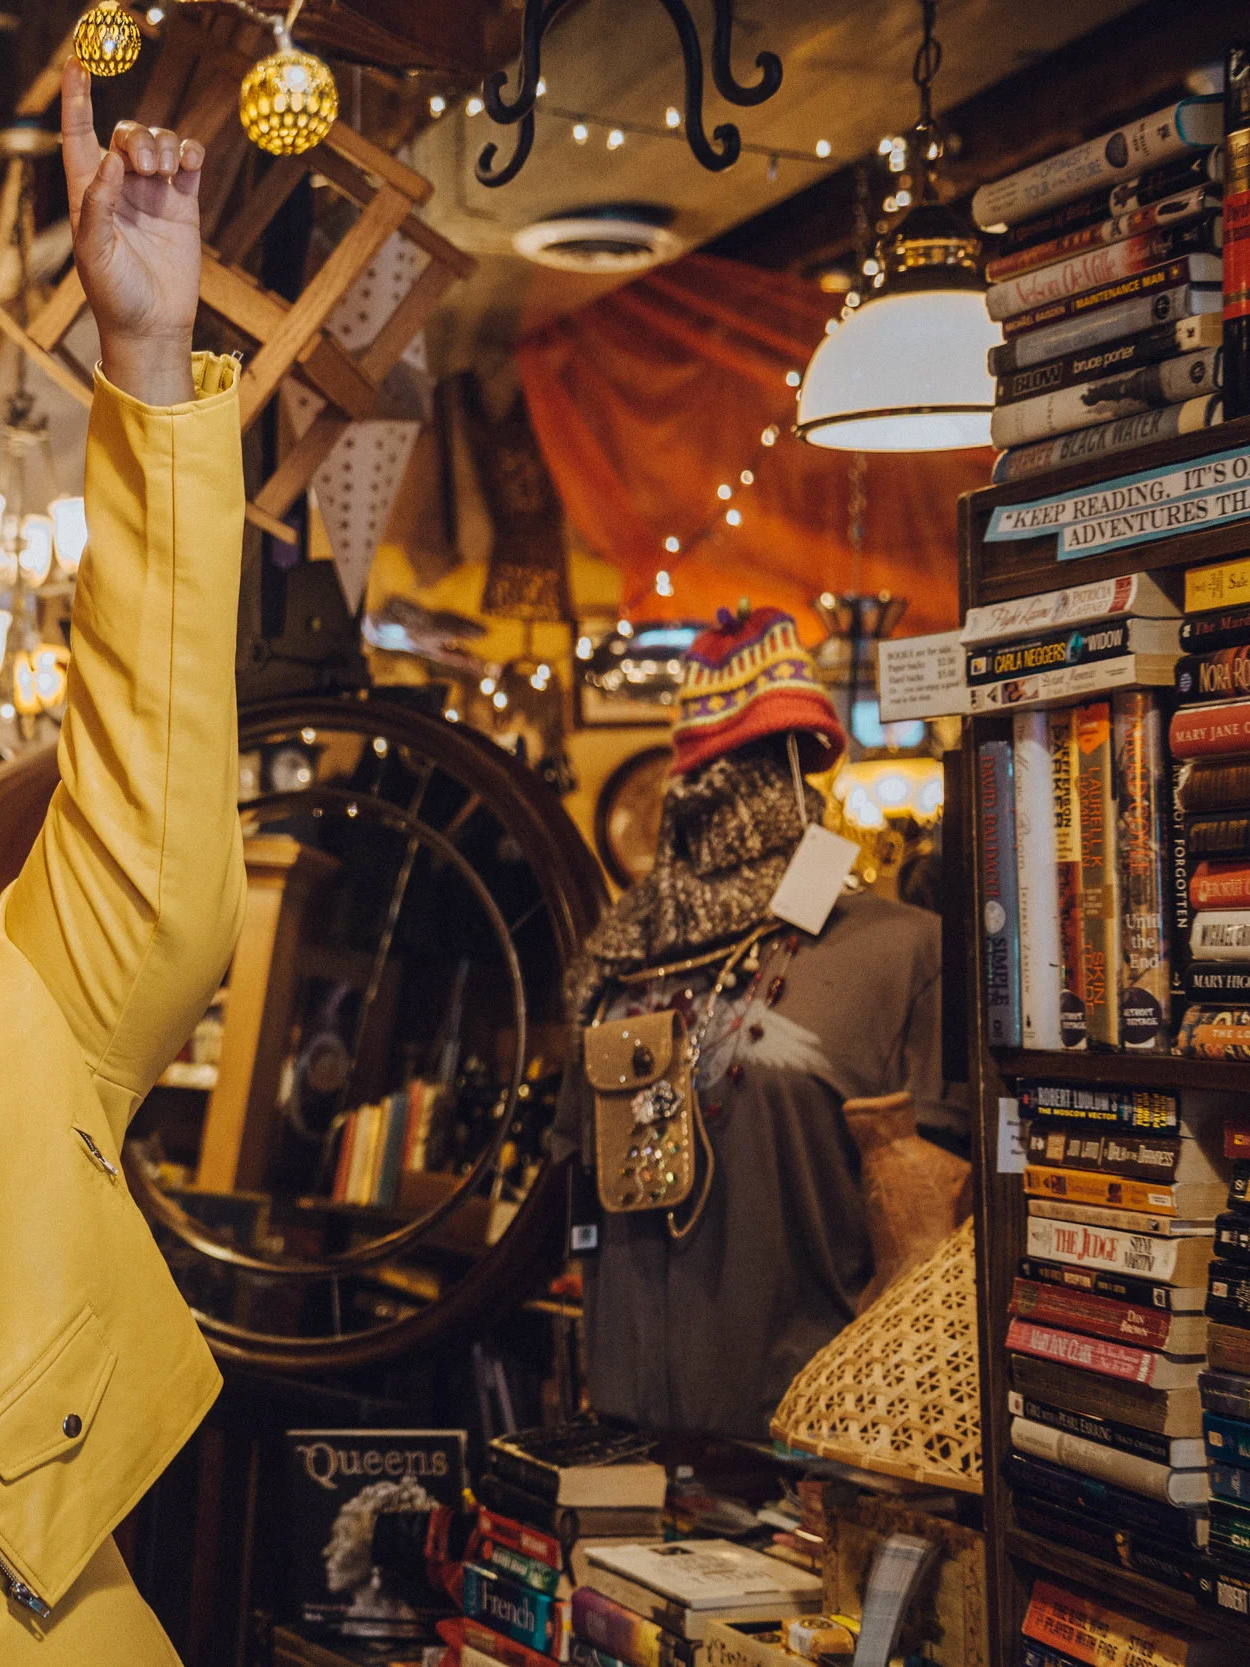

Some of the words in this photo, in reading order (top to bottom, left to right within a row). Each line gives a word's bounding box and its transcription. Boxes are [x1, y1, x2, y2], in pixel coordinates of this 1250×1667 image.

[1075, 280, 1140, 309] MAINTENANCE
[1142, 271, 1165, 288] MAN
[1073, 357, 1102, 375] bruce
[1103, 345, 1135, 367] porter
[1072, 481, 1171, 521] READING.
[1183, 463, 1226, 491] IT'S
[1233, 456, 1250, 478] O
[1068, 499, 1208, 547] ADVENTURES
[1216, 489, 1250, 516] TH
[995, 650, 1022, 674] CARLA
[1023, 643, 1066, 670] NEGGERS
[1199, 662, 1232, 693] NORA
[1175, 727, 1207, 743] MARY
[1210, 723, 1240, 741] JANE
[980, 755, 997, 809] DAVID
[1062, 741, 1072, 828] JEFFERSON
[1089, 767, 1103, 847] LAURELL
[984, 814, 1000, 897] BALDACCI
[1127, 803, 1151, 877] COYLE
[1173, 839, 1188, 928] FORGOTTEN
[1125, 913, 1161, 930] Until
[1131, 934, 1155, 949] the
[992, 938, 1009, 1005] SIMPLE
[1092, 951, 1105, 1005] SKIN
[1129, 953, 1160, 969] End
[1192, 974, 1223, 989] MARY
[1038, 1087, 1071, 1108] ROBERT
[1038, 1107, 1051, 1115] THE
[1053, 1108, 1086, 1119] MOSCOW
[1088, 1111, 1118, 1121] VECTOR
[1055, 1227, 1079, 1254] THE
[1078, 1228, 1119, 1262] JUDGE
[295, 1442, 449, 1490] Queens
[482, 1578, 535, 1632] French
